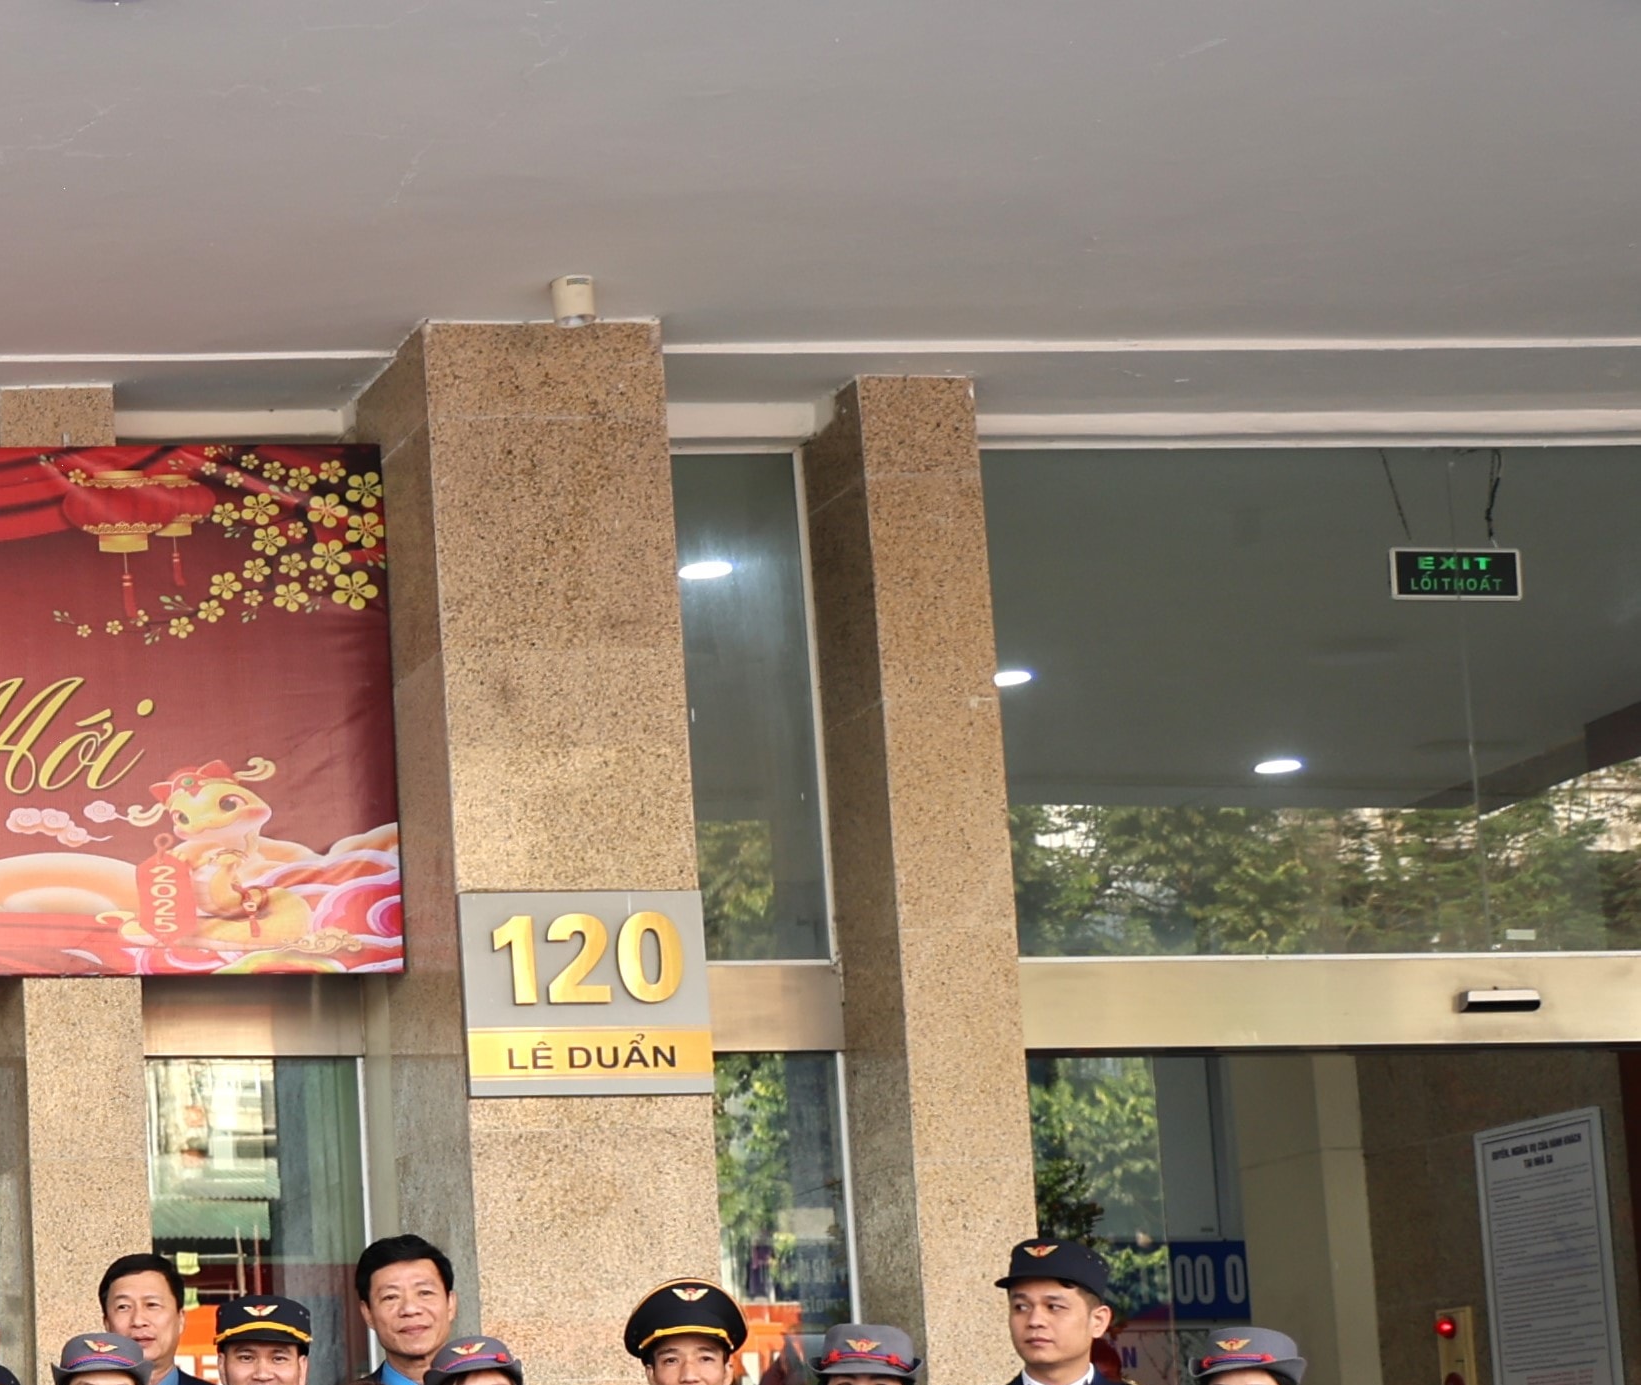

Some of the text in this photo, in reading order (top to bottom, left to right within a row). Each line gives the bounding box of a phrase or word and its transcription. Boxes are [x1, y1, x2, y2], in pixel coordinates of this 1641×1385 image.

[1418, 556, 1492, 570] EXIT
[149, 865, 178, 933] 2025
[492, 911, 684, 1005] 120
[507, 1033, 677, 1070] LÊ DUẨN
